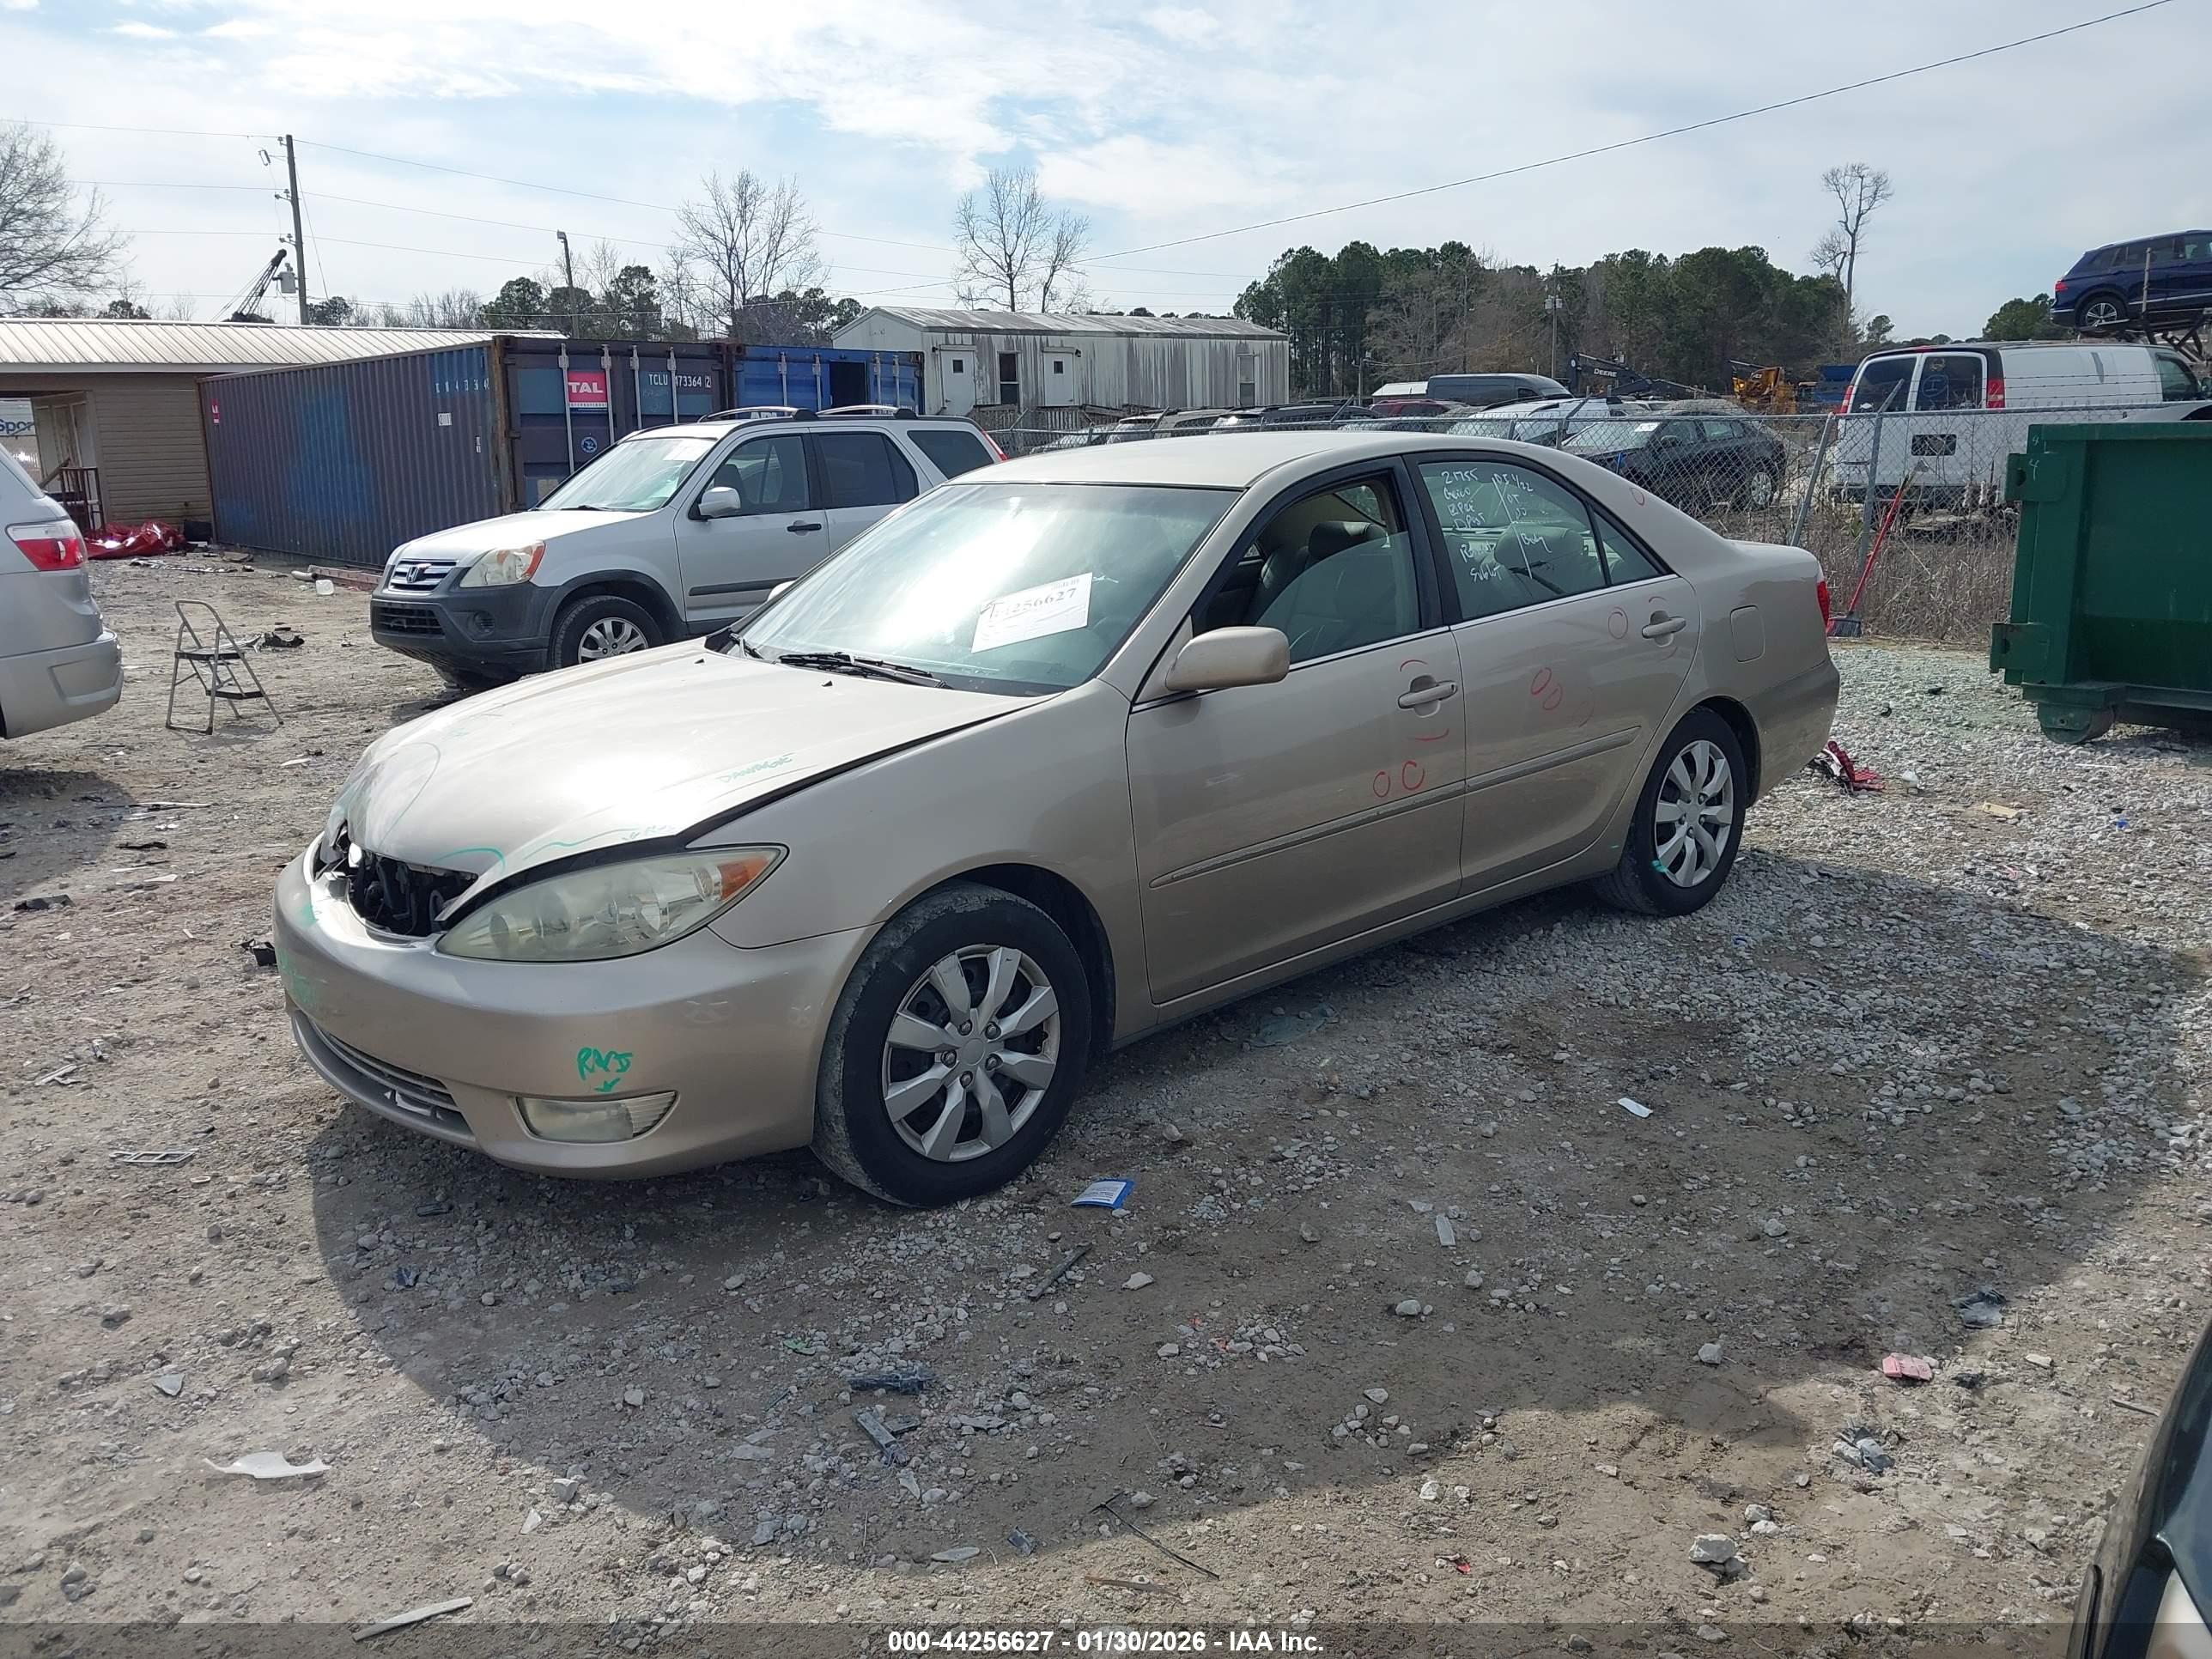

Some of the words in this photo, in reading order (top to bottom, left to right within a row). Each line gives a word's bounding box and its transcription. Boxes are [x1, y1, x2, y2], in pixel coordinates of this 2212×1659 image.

[1594, 368, 1617, 378] DEERE
[648, 374, 668, 386] TCLU
[568, 381, 604, 393] TAL
